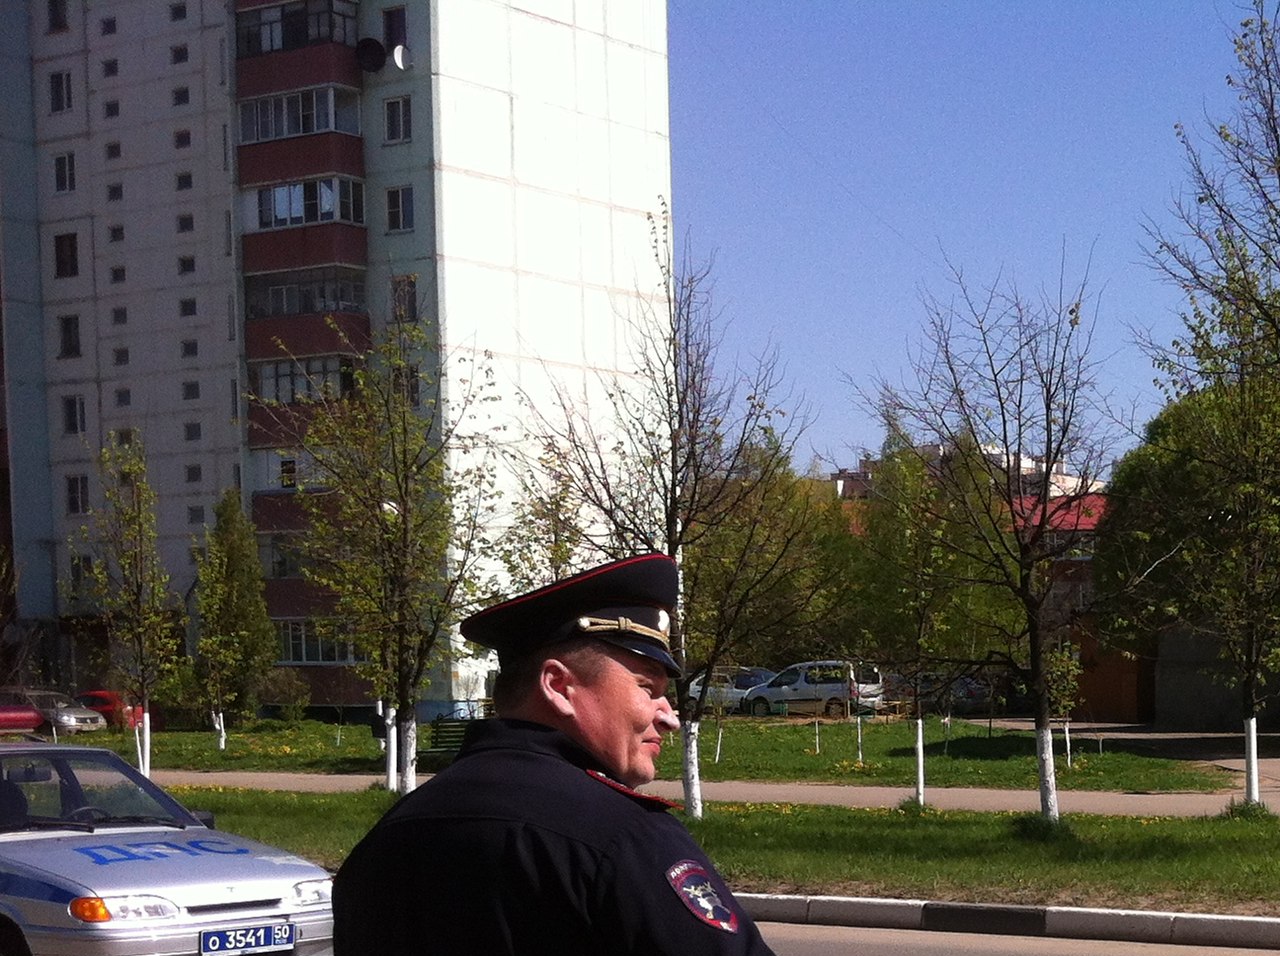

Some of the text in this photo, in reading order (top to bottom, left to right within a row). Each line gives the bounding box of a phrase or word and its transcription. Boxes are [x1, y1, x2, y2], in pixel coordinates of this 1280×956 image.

[73, 840, 249, 866] ДПС
[225, 928, 266, 949] 3541
[274, 925, 290, 939] 50
